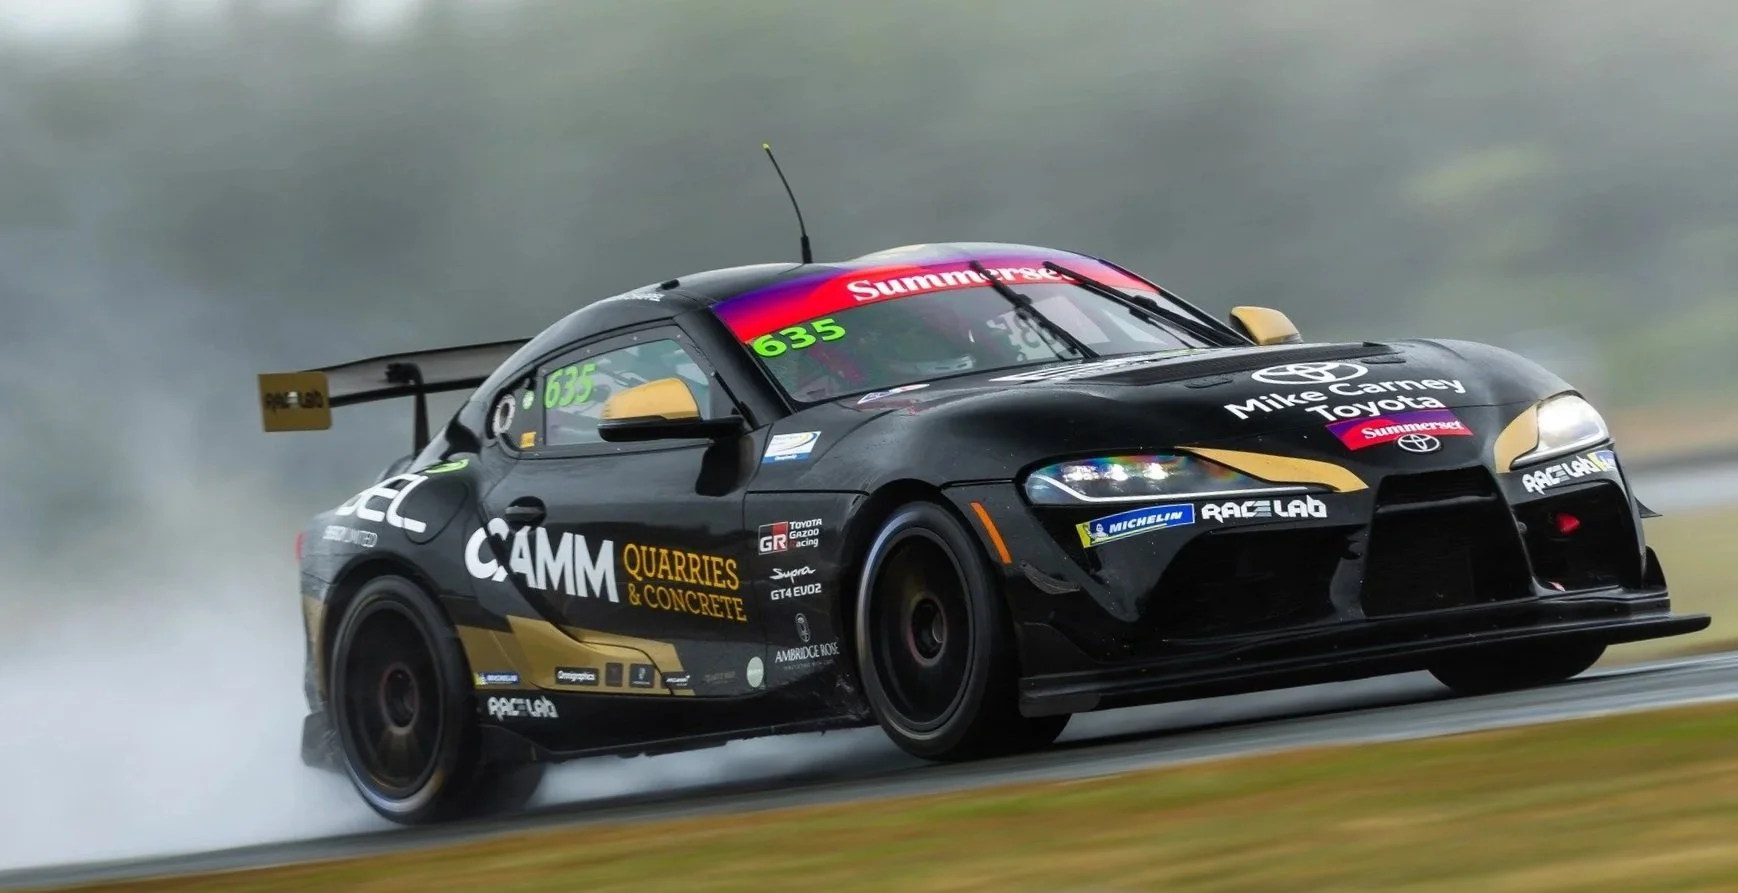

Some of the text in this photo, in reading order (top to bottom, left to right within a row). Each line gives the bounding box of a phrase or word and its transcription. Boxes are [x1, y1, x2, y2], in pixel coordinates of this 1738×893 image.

[847, 266, 1076, 301] Summerse
[752, 317, 847, 357] 635
[544, 362, 598, 409] 635
[1223, 378, 1467, 421] Mike Carney
[1305, 395, 1447, 422] Toyota
[1361, 419, 1465, 440] Summerset
[789, 518, 823, 530] TOYOTA
[789, 528, 820, 540] GAZOO
[1108, 510, 1184, 535] MICHELIN
[760, 533, 787, 552] GR
[465, 517, 620, 604] CAMM
[623, 543, 740, 591] QUARRIES
[769, 566, 817, 584] Supra
[628, 583, 748, 622] & CONCRETE
[770, 583, 822, 601] GT4 EVO2
[774, 641, 840, 664] AMBRIDGE ROSE
